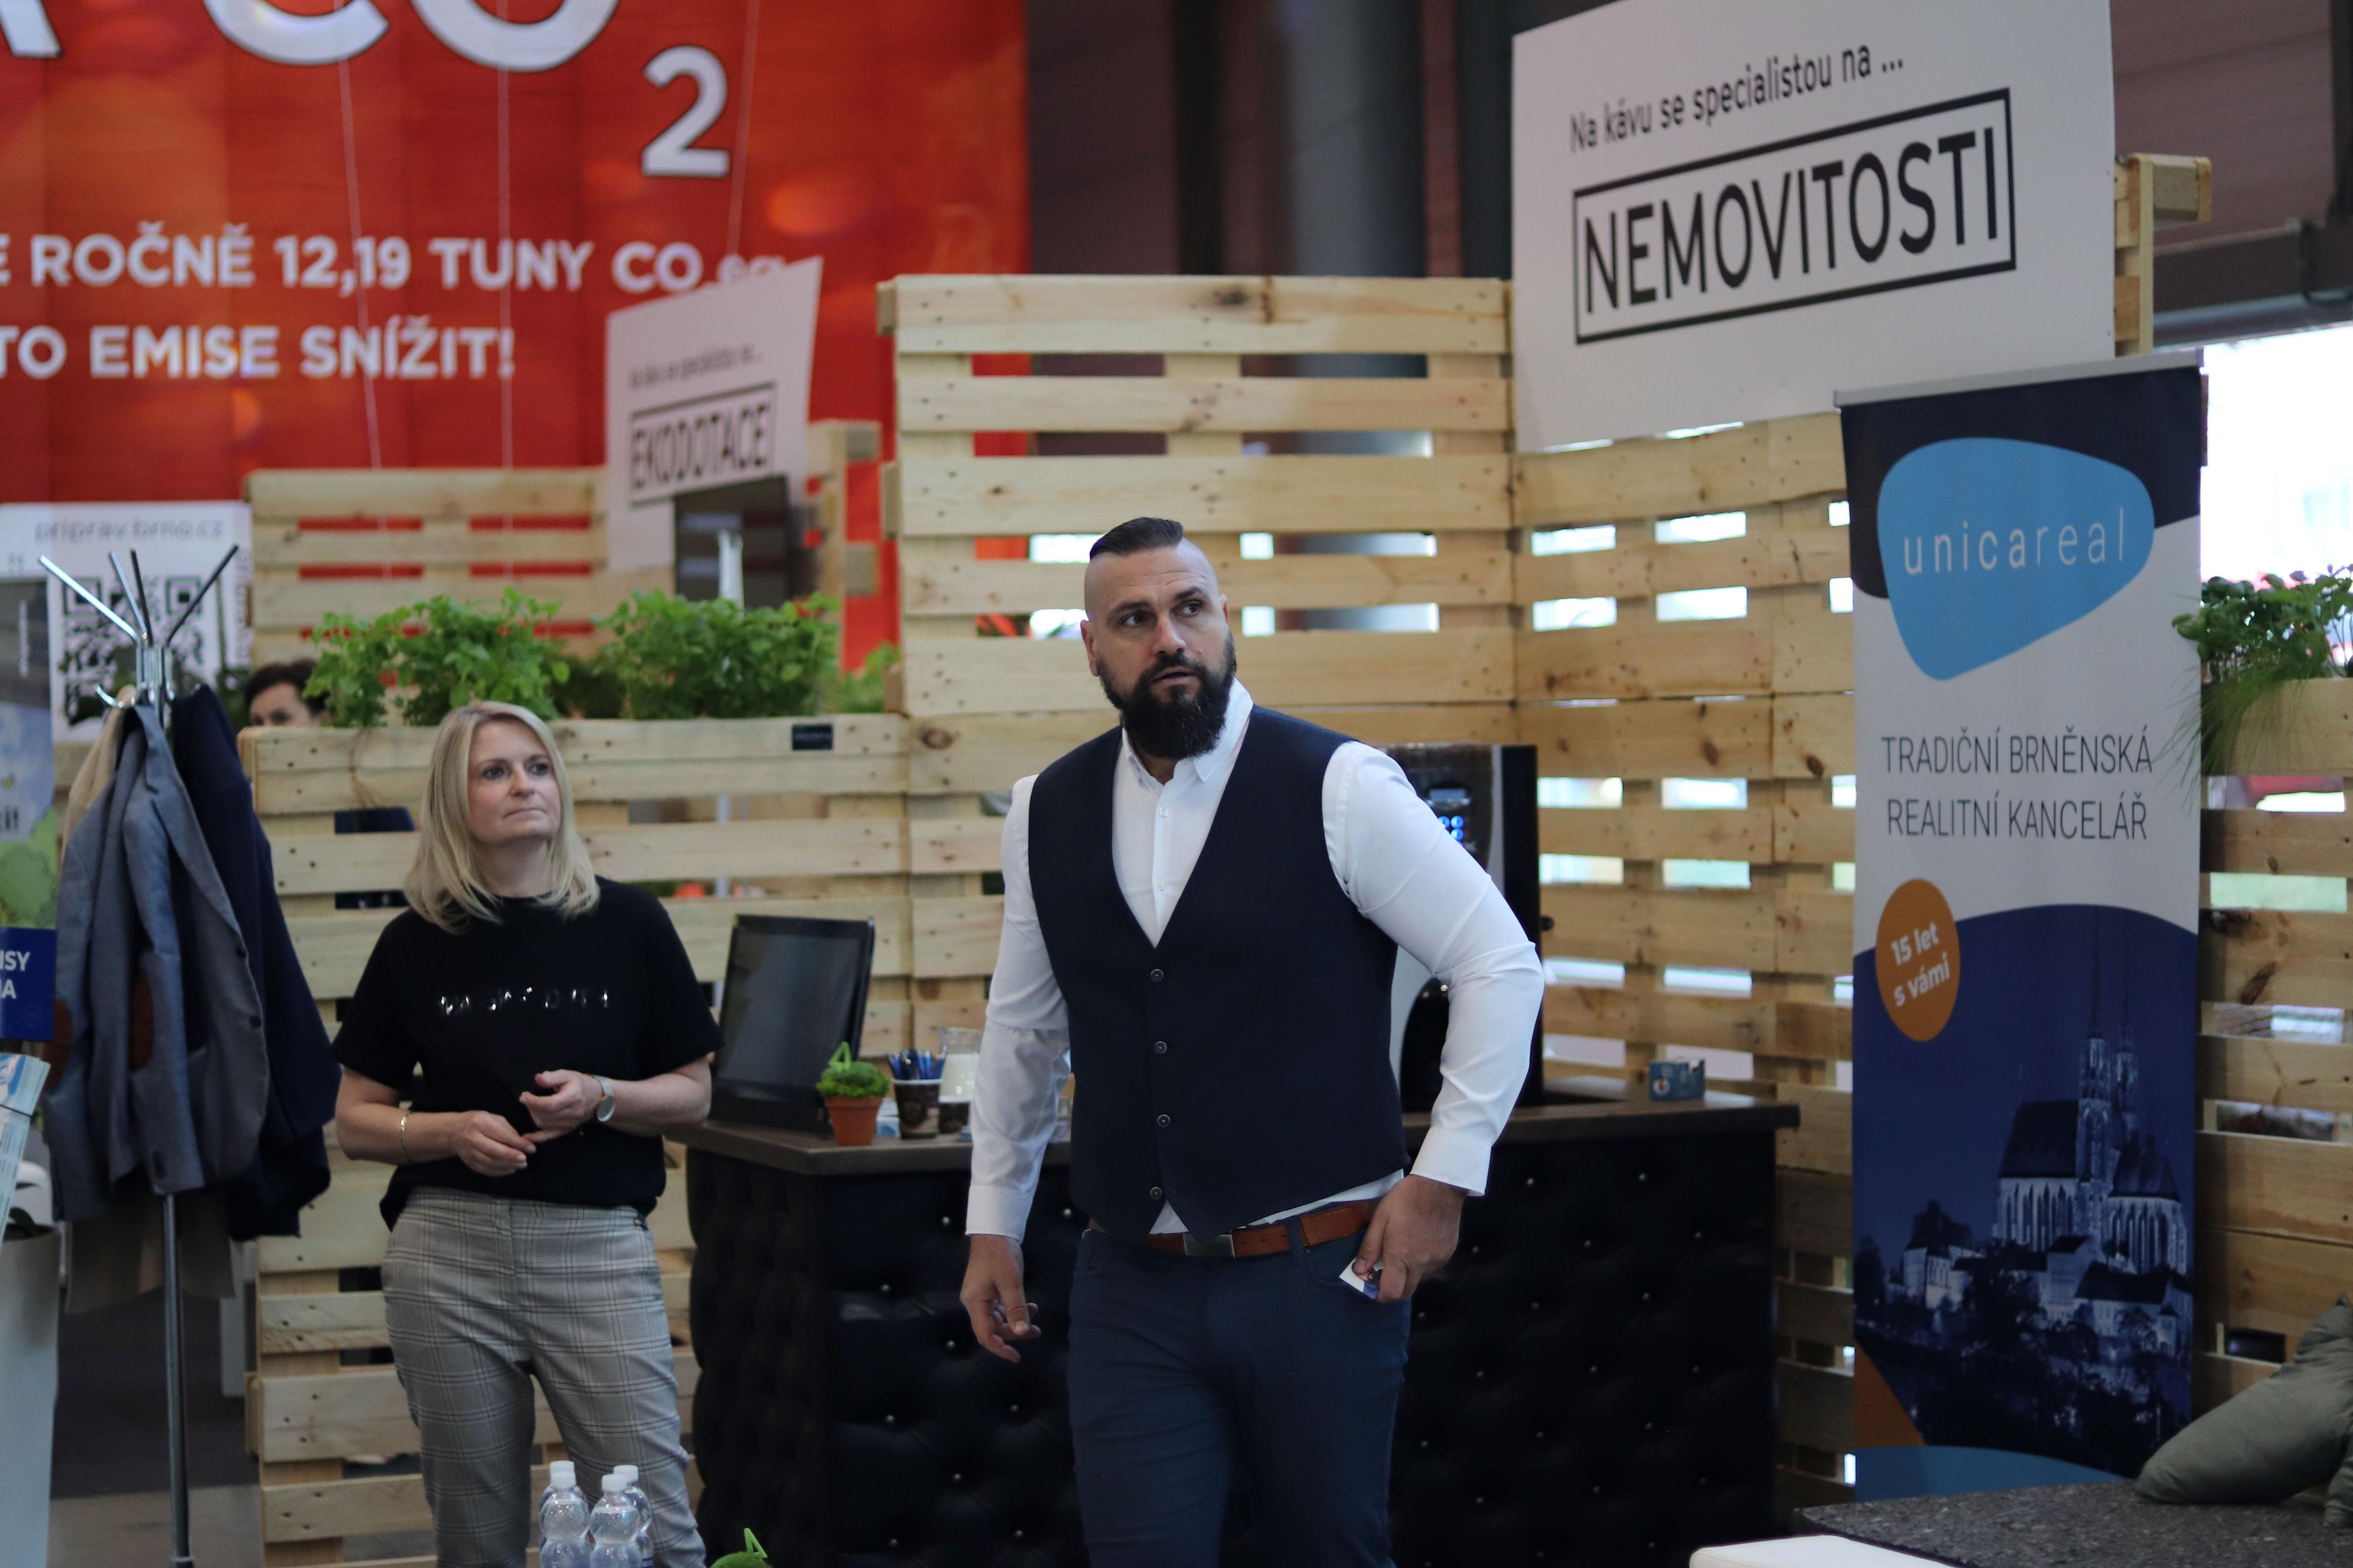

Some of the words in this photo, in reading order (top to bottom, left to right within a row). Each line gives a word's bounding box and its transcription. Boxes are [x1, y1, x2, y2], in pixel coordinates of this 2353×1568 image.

[1570, 113, 1597, 151] Na
[1604, 96, 1651, 143] kávu
[1659, 95, 1684, 129] se
[1692, 53, 1832, 126] specialistou
[1842, 44, 1871, 83] na
[1584, 126, 1998, 314] NEMOVITOSTI
[31, 221, 255, 287] ROČNĚ
[275, 235, 412, 298] 12,19
[428, 236, 594, 292] TUNY
[89, 325, 281, 380] EMISE
[299, 314, 516, 381] SNÍŽIT!
[1904, 506, 2125, 575] unicareal
[1881, 725, 2001, 774] TRADIČNÍ
[2009, 725, 2153, 774] BRNĚNSKÁ
[1888, 790, 2000, 838] REALITNÍ
[2008, 791, 2147, 840] KANCELÁŘ
[1891, 934, 1912, 966] 15
[1914, 921, 1939, 955] let
[1894, 985, 1906, 1007] s
[1908, 950, 1951, 999] vámi
